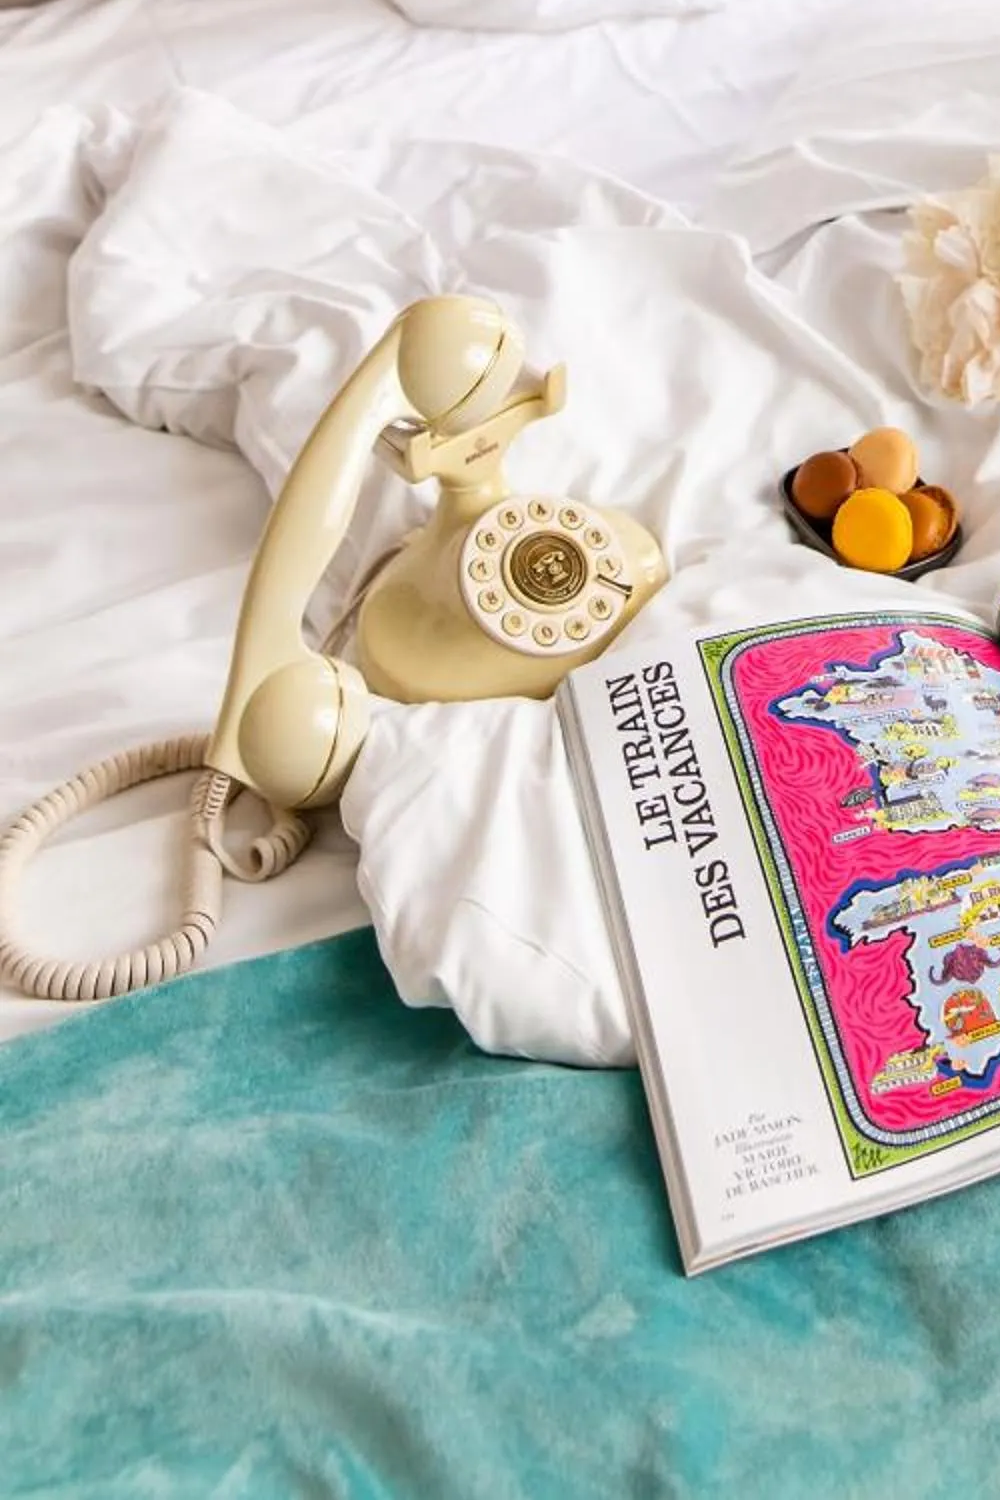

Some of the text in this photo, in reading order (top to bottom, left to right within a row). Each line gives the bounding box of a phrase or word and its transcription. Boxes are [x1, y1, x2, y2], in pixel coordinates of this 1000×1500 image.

[605, 673, 678, 850] LE TRAIN
[642, 660, 746, 949] DES VACANCES
